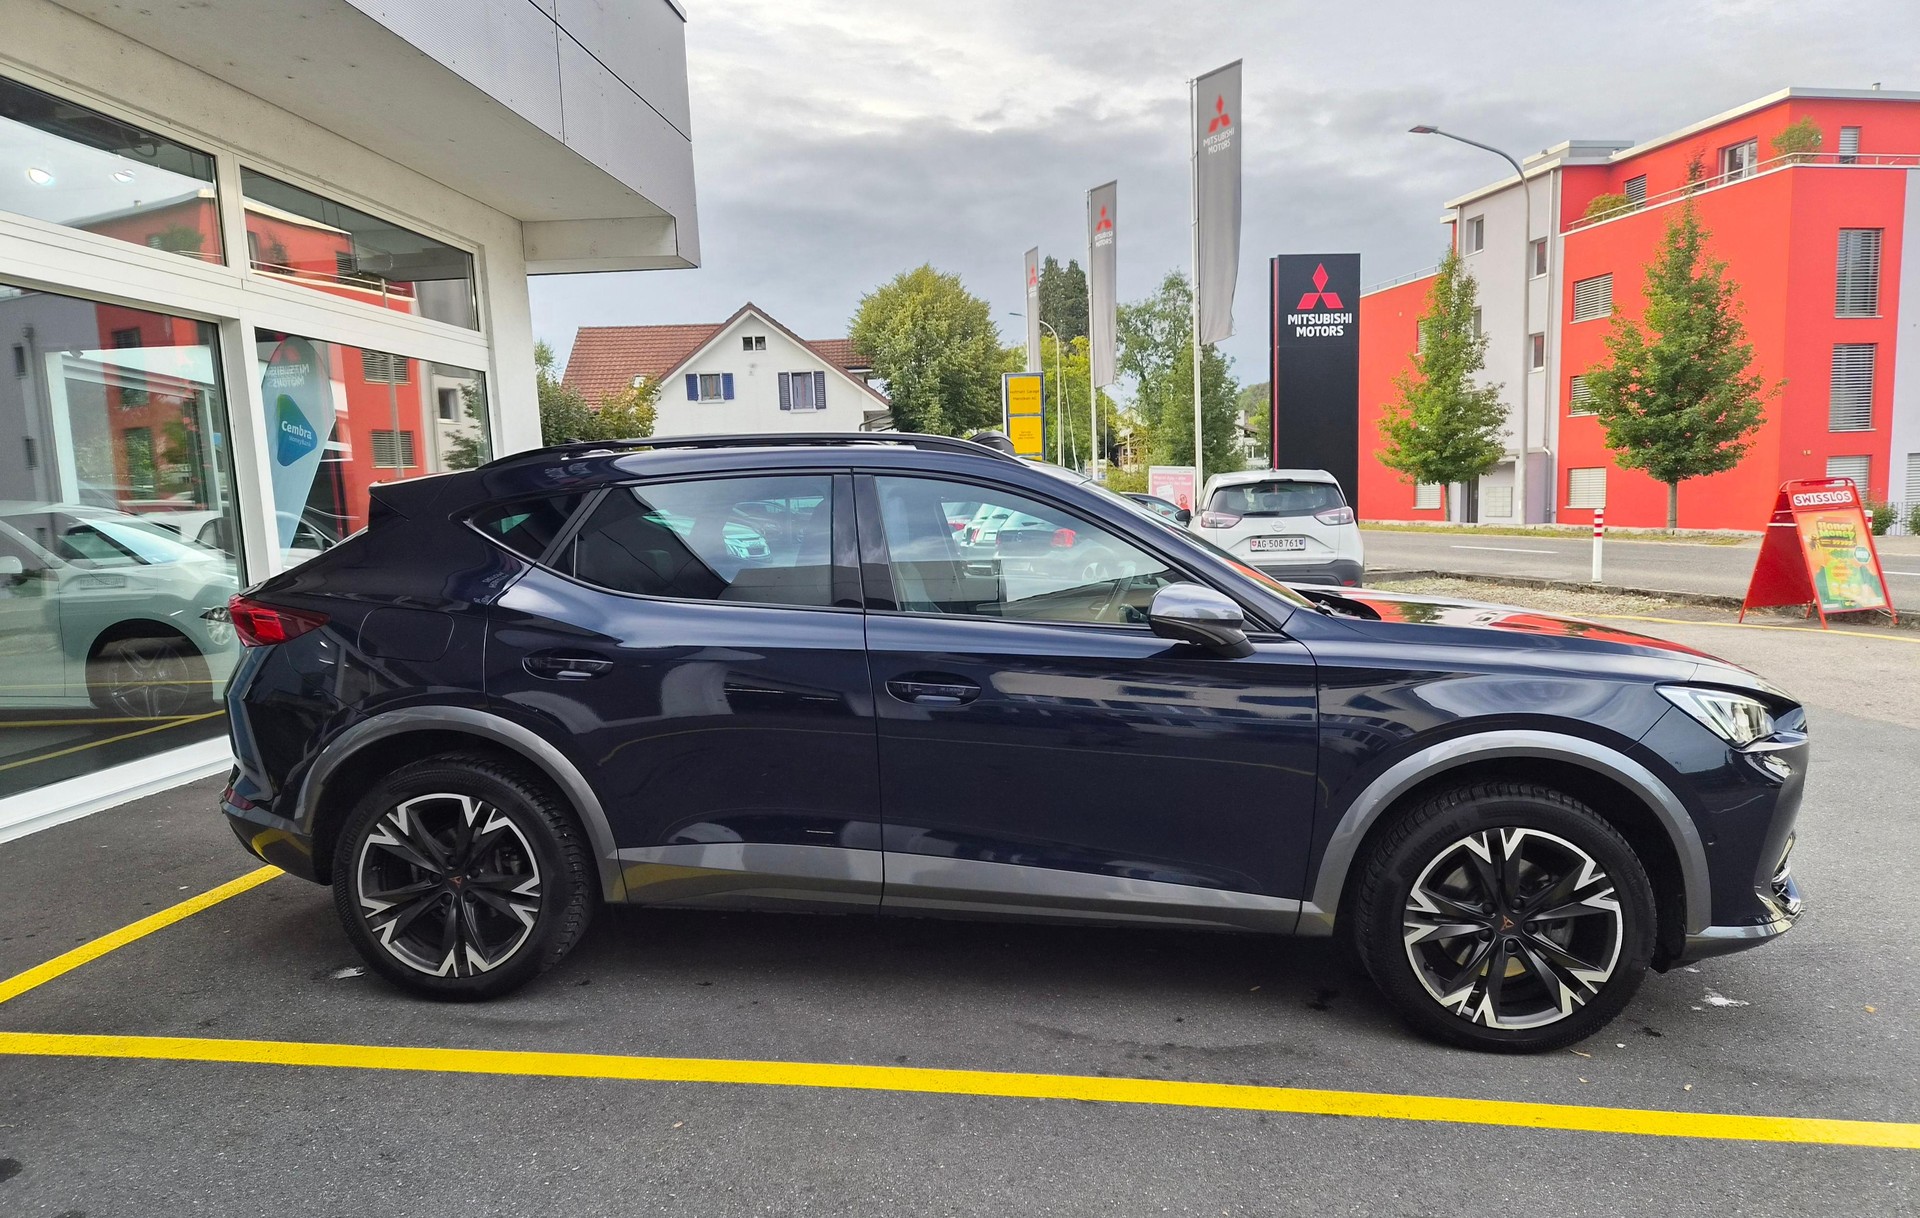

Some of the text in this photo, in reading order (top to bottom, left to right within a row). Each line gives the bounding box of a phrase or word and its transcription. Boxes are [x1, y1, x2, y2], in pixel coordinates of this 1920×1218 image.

[1203, 127, 1234, 147] MITSUBISHI
[1208, 138, 1230, 154] MOTORS
[1287, 313, 1352, 325] MITSUBISHI
[1296, 325, 1344, 337] MOTORS
[281, 420, 312, 440] Cembra
[1794, 492, 1851, 505] SWISSLOS
[1817, 521, 1854, 532] Honey
[1819, 530, 1856, 540] Money
[1257, 540, 1267, 548] AG
